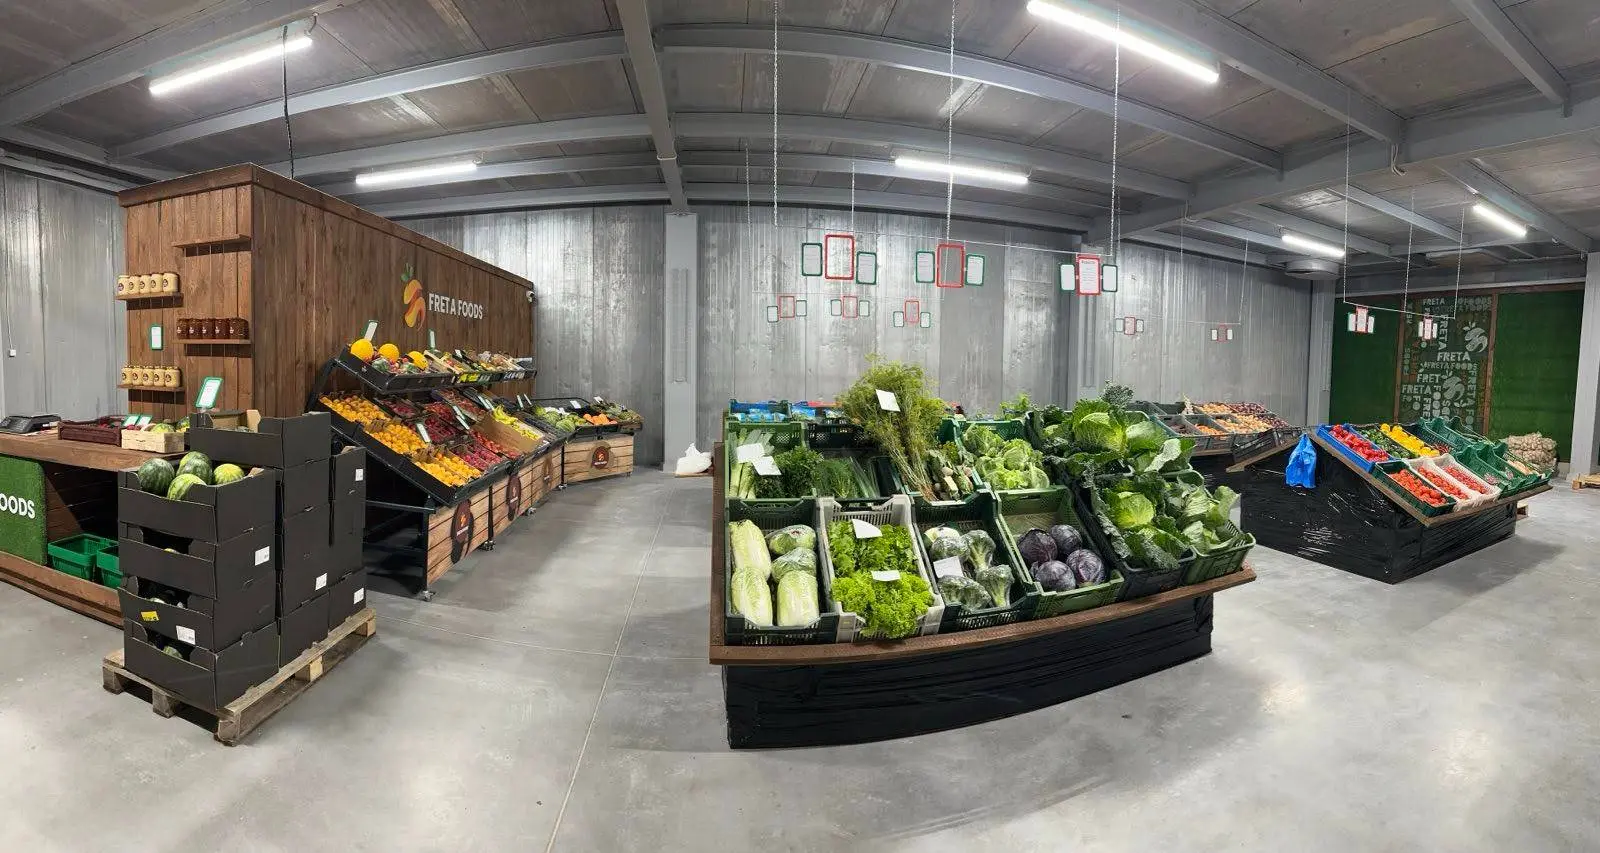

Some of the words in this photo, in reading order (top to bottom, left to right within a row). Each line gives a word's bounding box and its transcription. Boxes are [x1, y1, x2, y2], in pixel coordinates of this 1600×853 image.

[428, 293, 456, 316] FRETA
[458, 300, 483, 320] FOODS
[1438, 314, 1449, 350] FRETA
[1437, 352, 1471, 361] FRETA
[1402, 385, 1432, 394] FRETA
[0, 493, 36, 519] OODS
